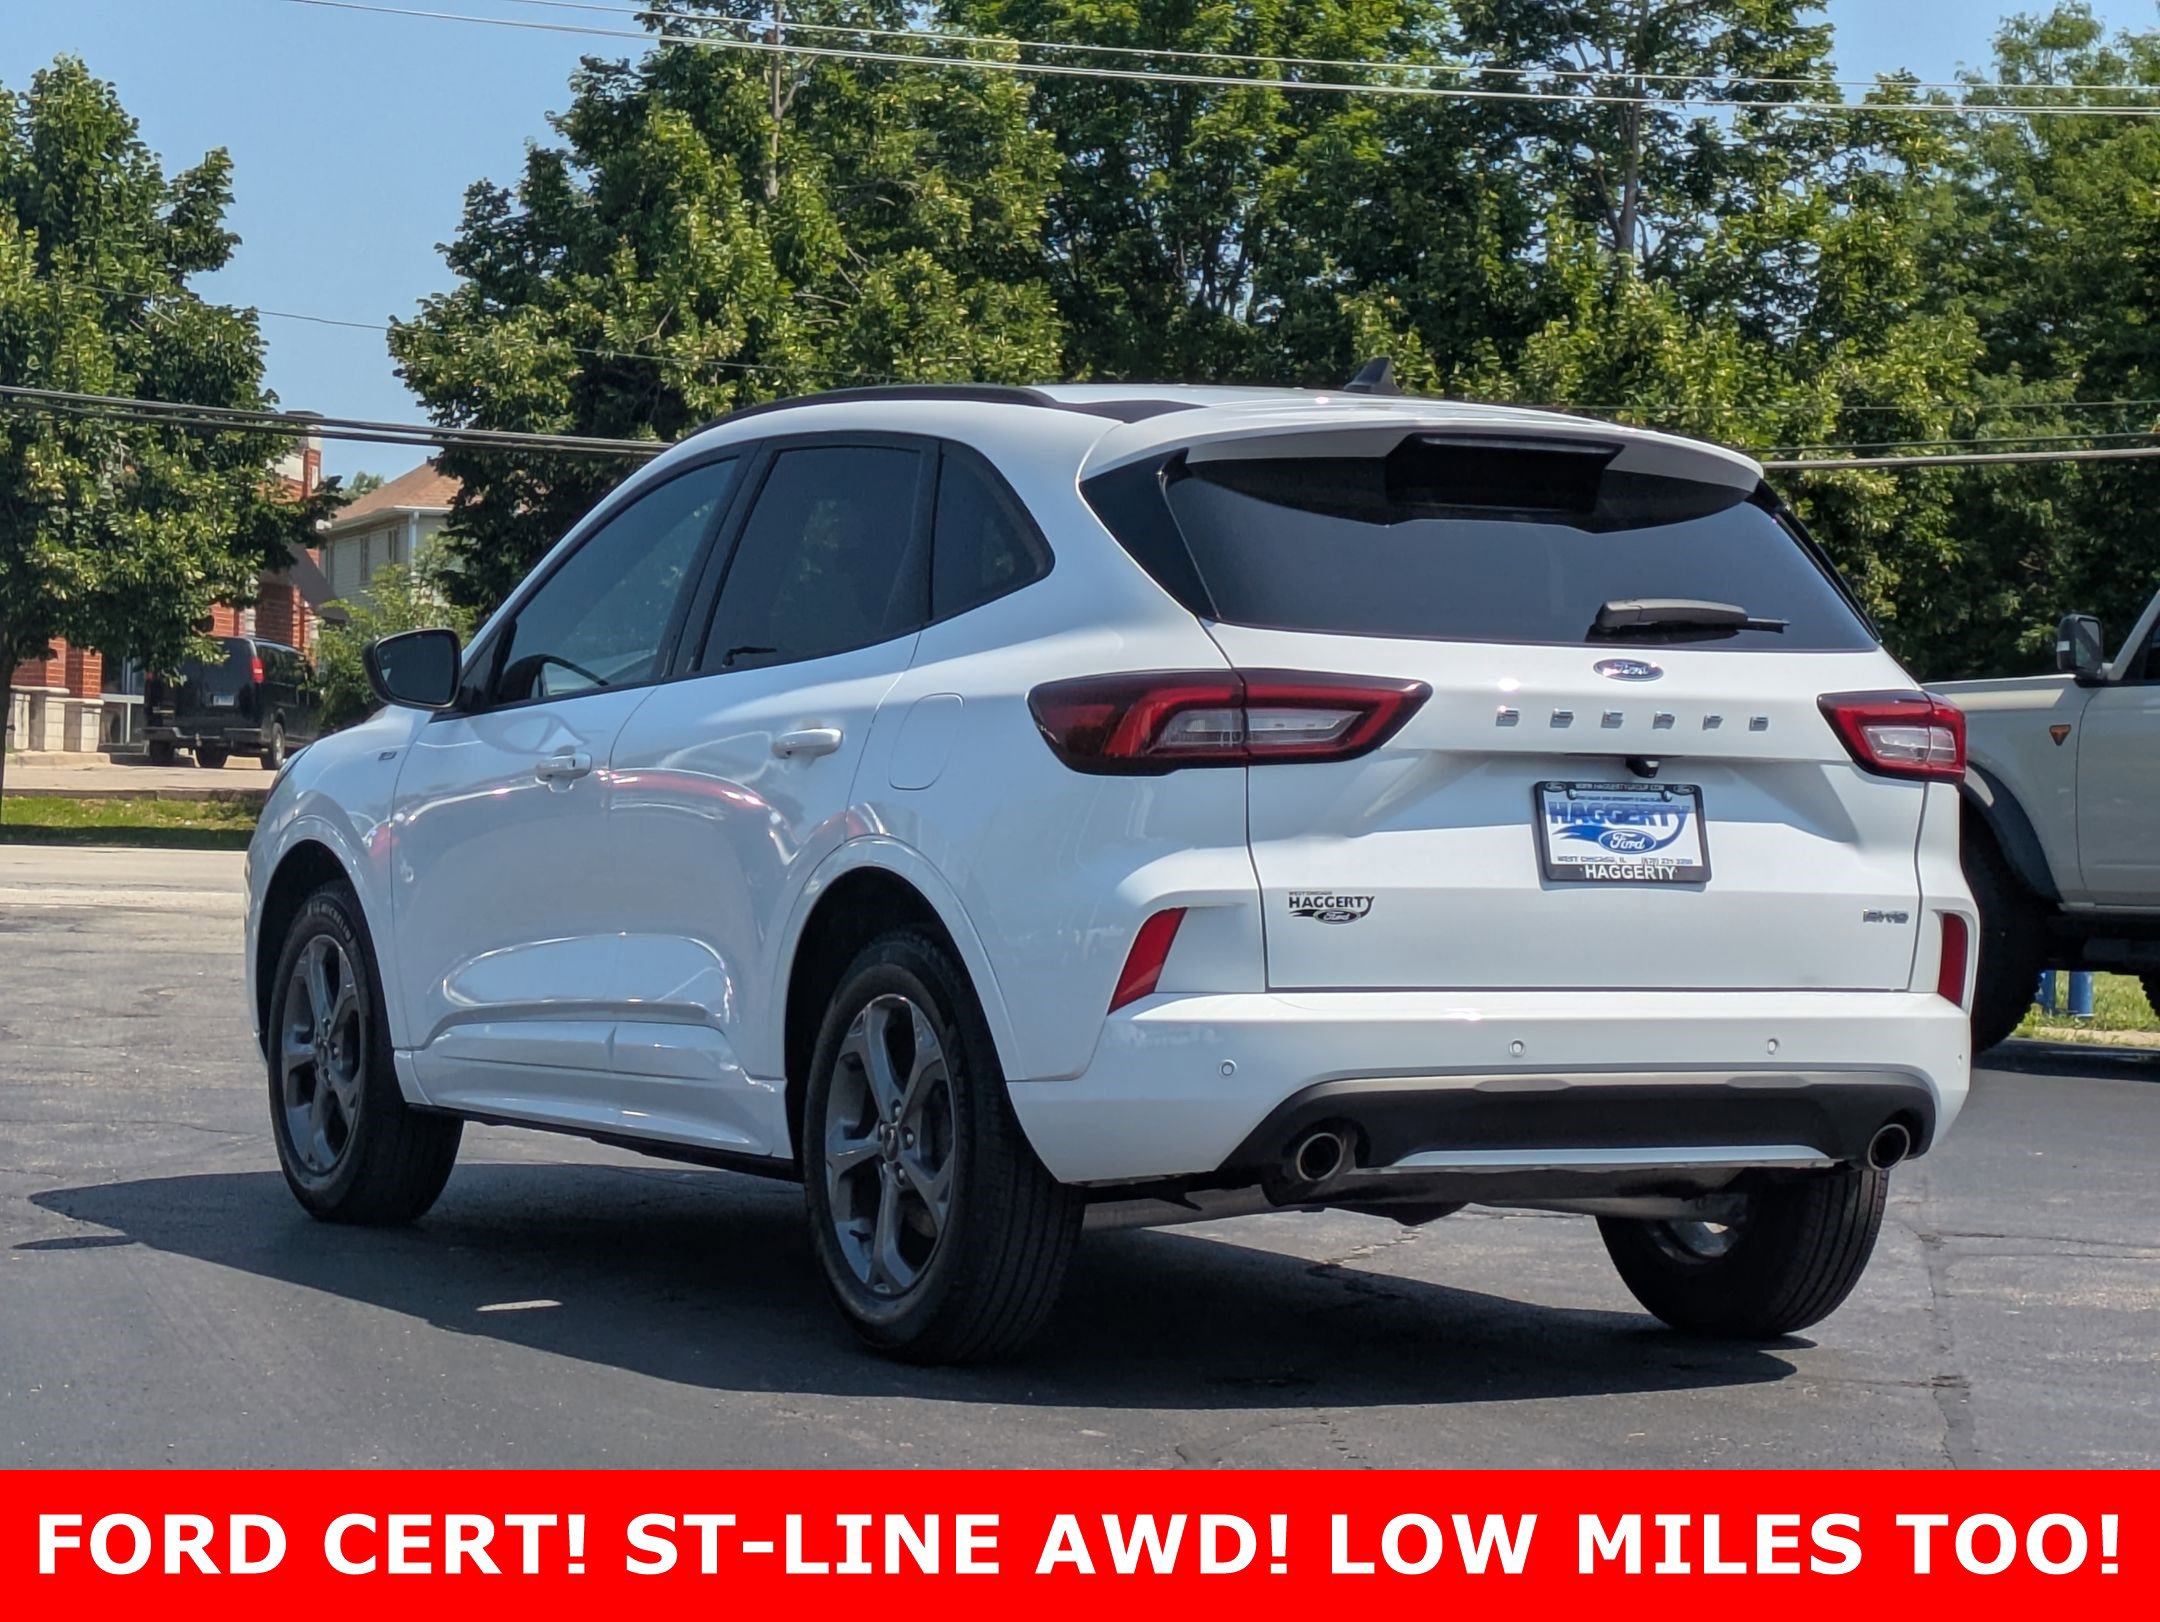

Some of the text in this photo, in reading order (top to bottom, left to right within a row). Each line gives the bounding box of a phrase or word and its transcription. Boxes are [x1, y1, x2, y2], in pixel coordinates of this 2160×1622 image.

[1549, 801, 1690, 827] HAGGERTY
[1609, 832, 1646, 850] Ford
[1584, 864, 1676, 880] HAGGERTY
[1288, 896, 1376, 909] HAGGERTY
